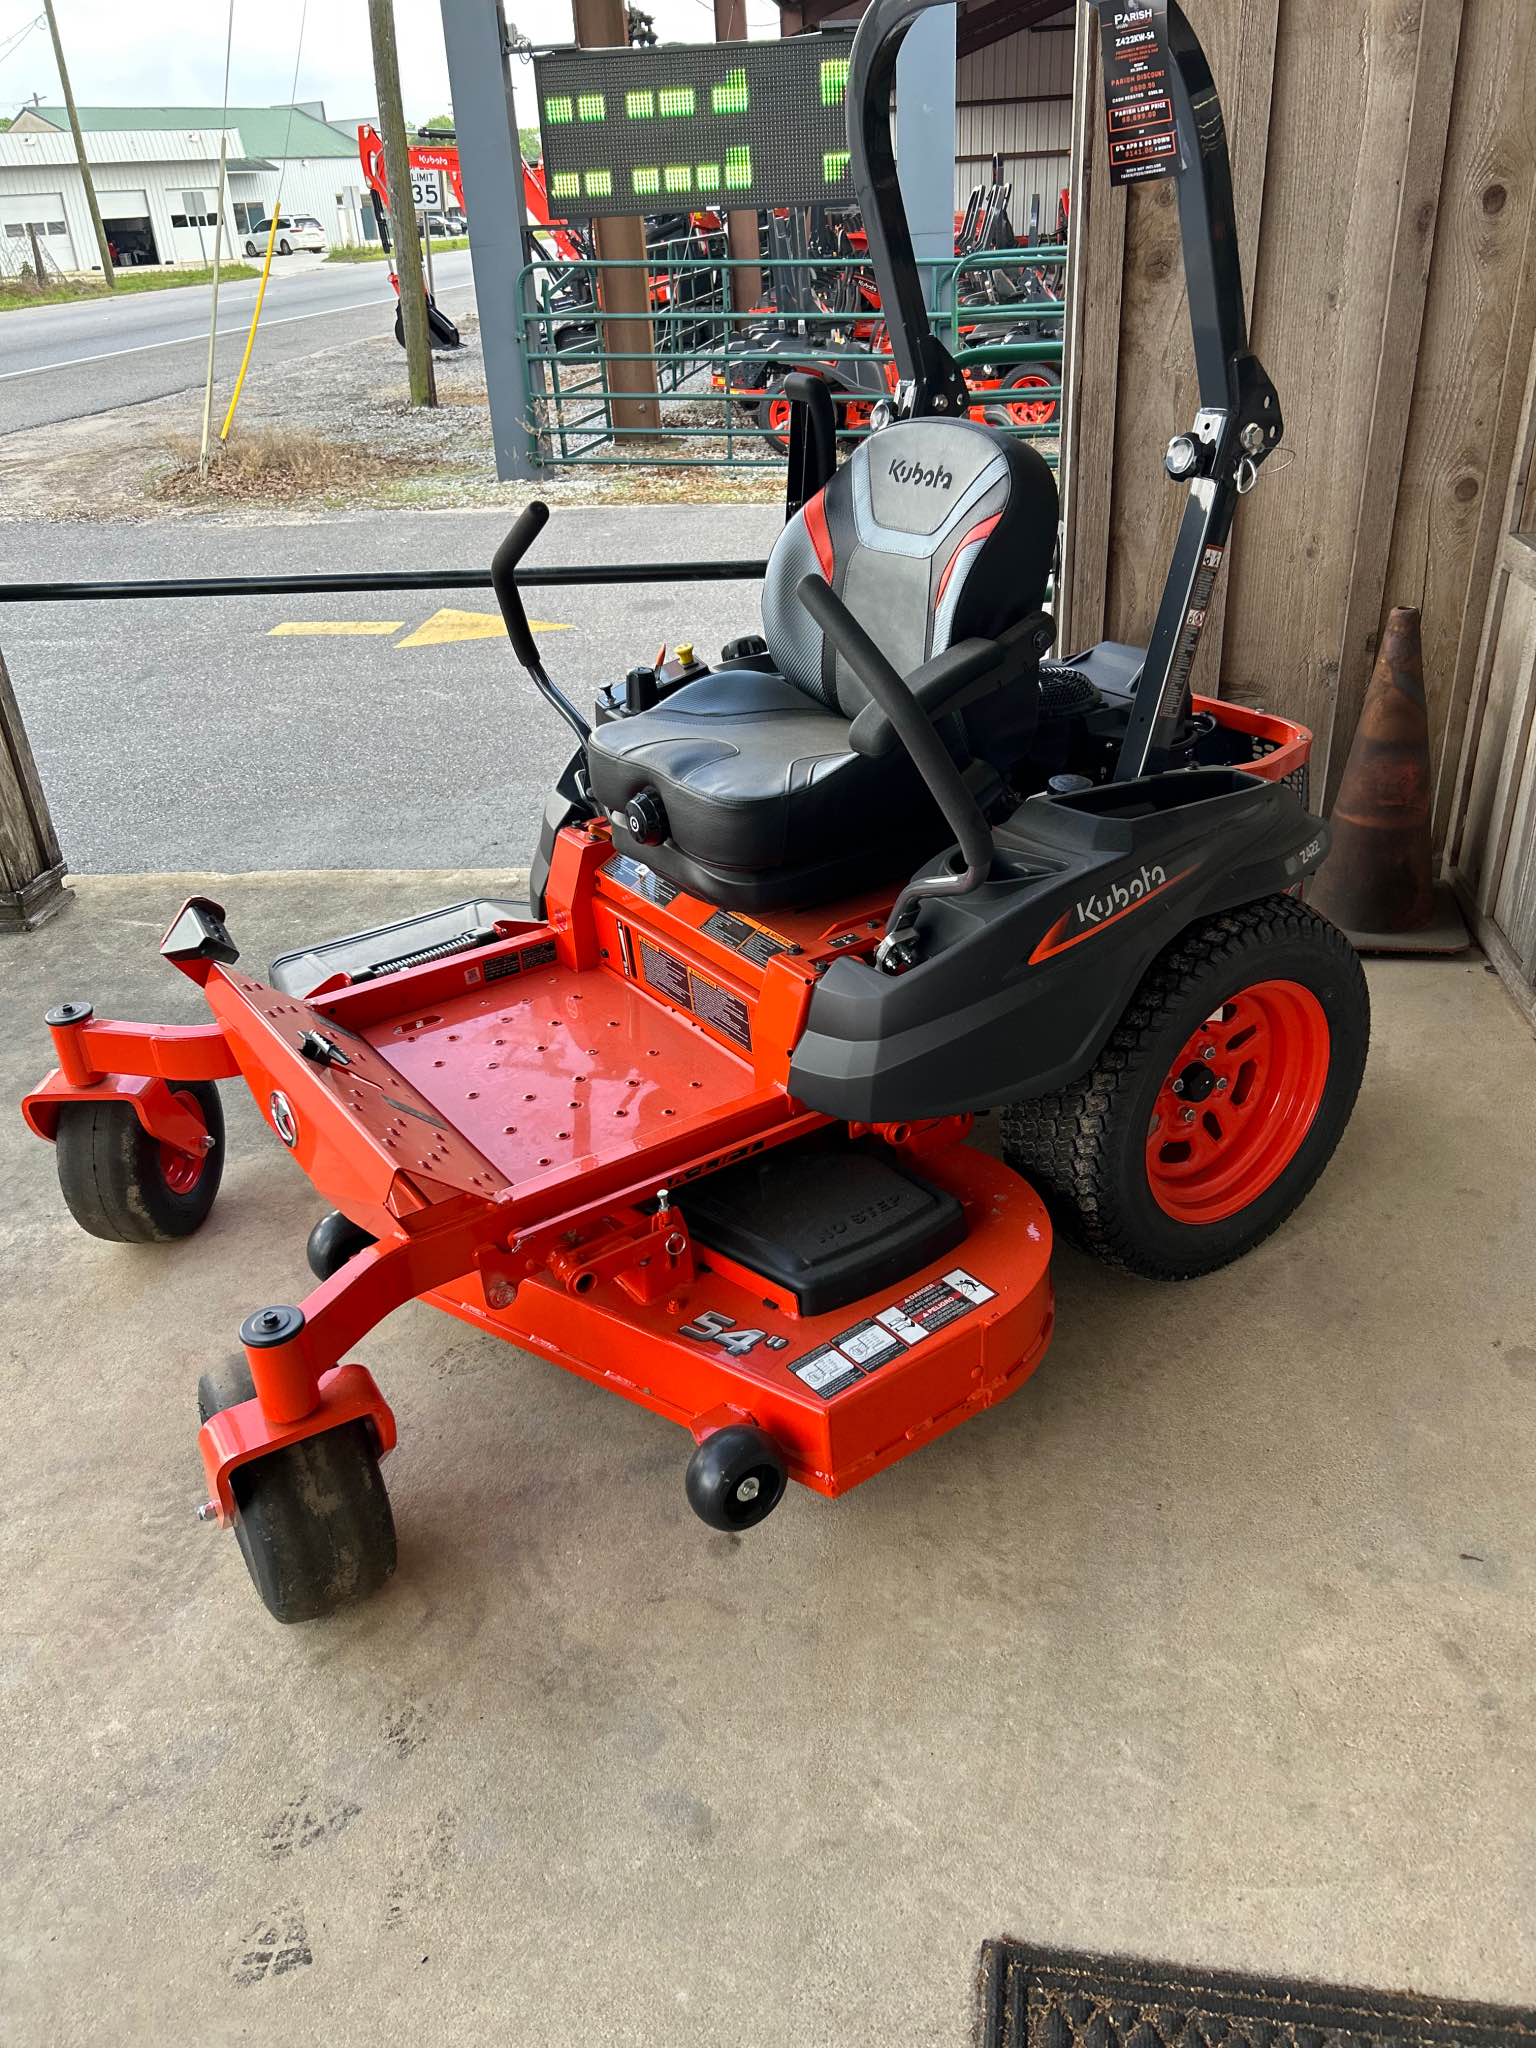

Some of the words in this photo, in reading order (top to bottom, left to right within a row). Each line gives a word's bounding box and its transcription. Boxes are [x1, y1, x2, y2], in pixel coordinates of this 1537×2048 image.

[1114, 8, 1153, 25] PARISH
[1111, 76, 1135, 87] PARISH
[1136, 70, 1165, 81] DISCOUNT
[1114, 108, 1136, 117] PARISH
[1137, 105, 1150, 113] LOW
[1151, 102, 1166, 110] PRICE
[1153, 136, 1170, 145] DOWN
[418, 155, 448, 165] Kubota
[411, 173, 434, 182] LIMIT
[412, 185, 438, 204] 35
[888, 458, 953, 490] Kubota
[1299, 840, 1321, 864] Z422
[1077, 864, 1166, 924] Kubota
[818, 1222, 848, 1244] NO
[850, 1193, 901, 1225] STEP
[909, 1284, 935, 1300] DANGER
[927, 1296, 955, 1314] PELIGRO
[678, 1309, 789, 1357] 54"
